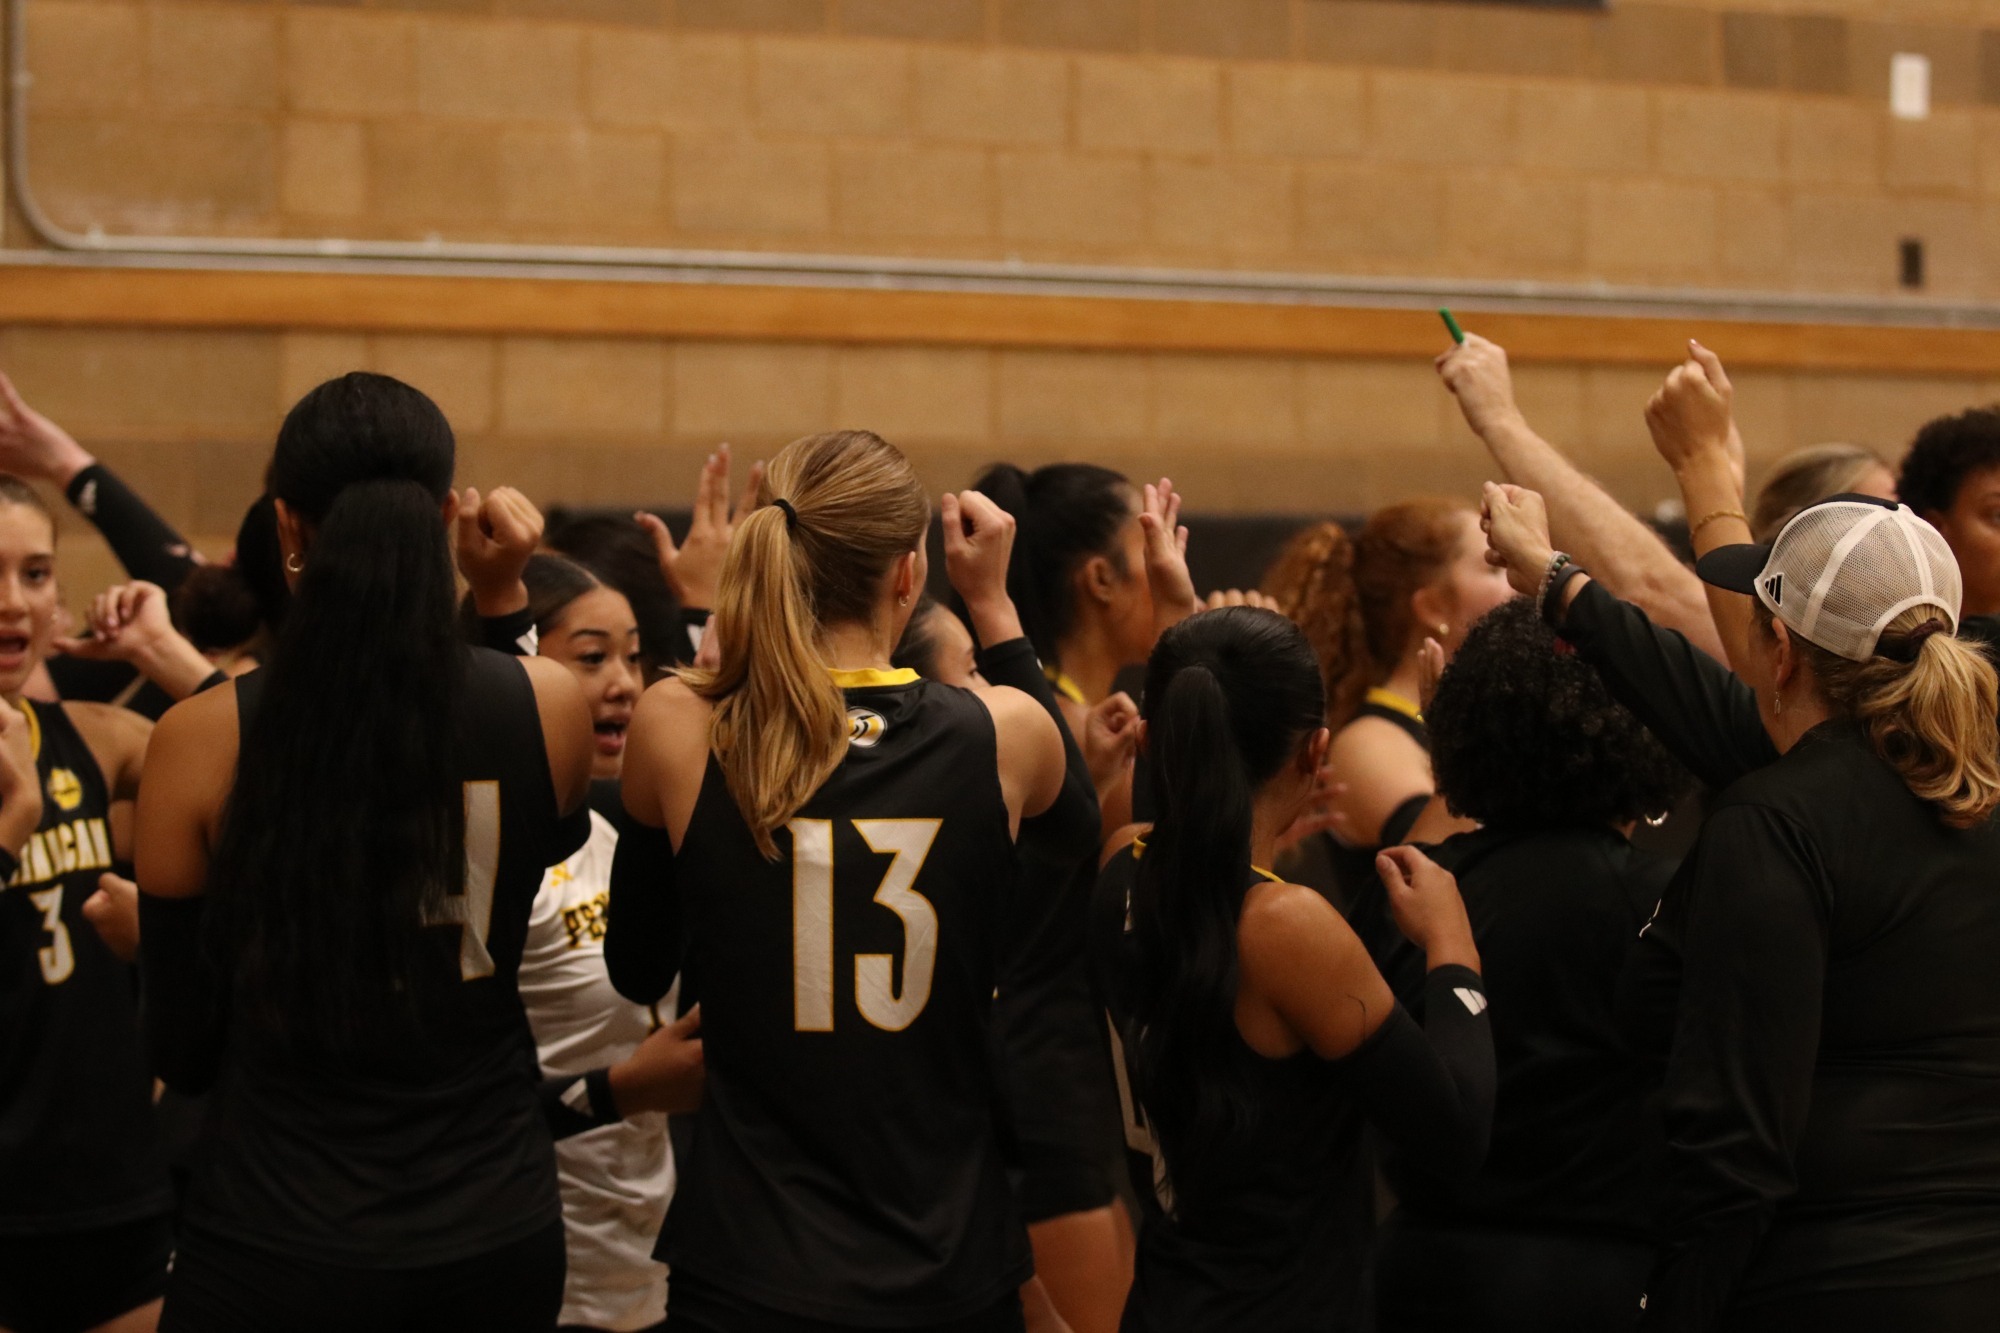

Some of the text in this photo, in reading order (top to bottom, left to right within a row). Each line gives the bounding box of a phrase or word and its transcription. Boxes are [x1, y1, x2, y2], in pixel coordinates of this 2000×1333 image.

[8, 818, 113, 887] INICAN
[29, 883, 75, 985] 3
[785, 817, 944, 1032] 13
